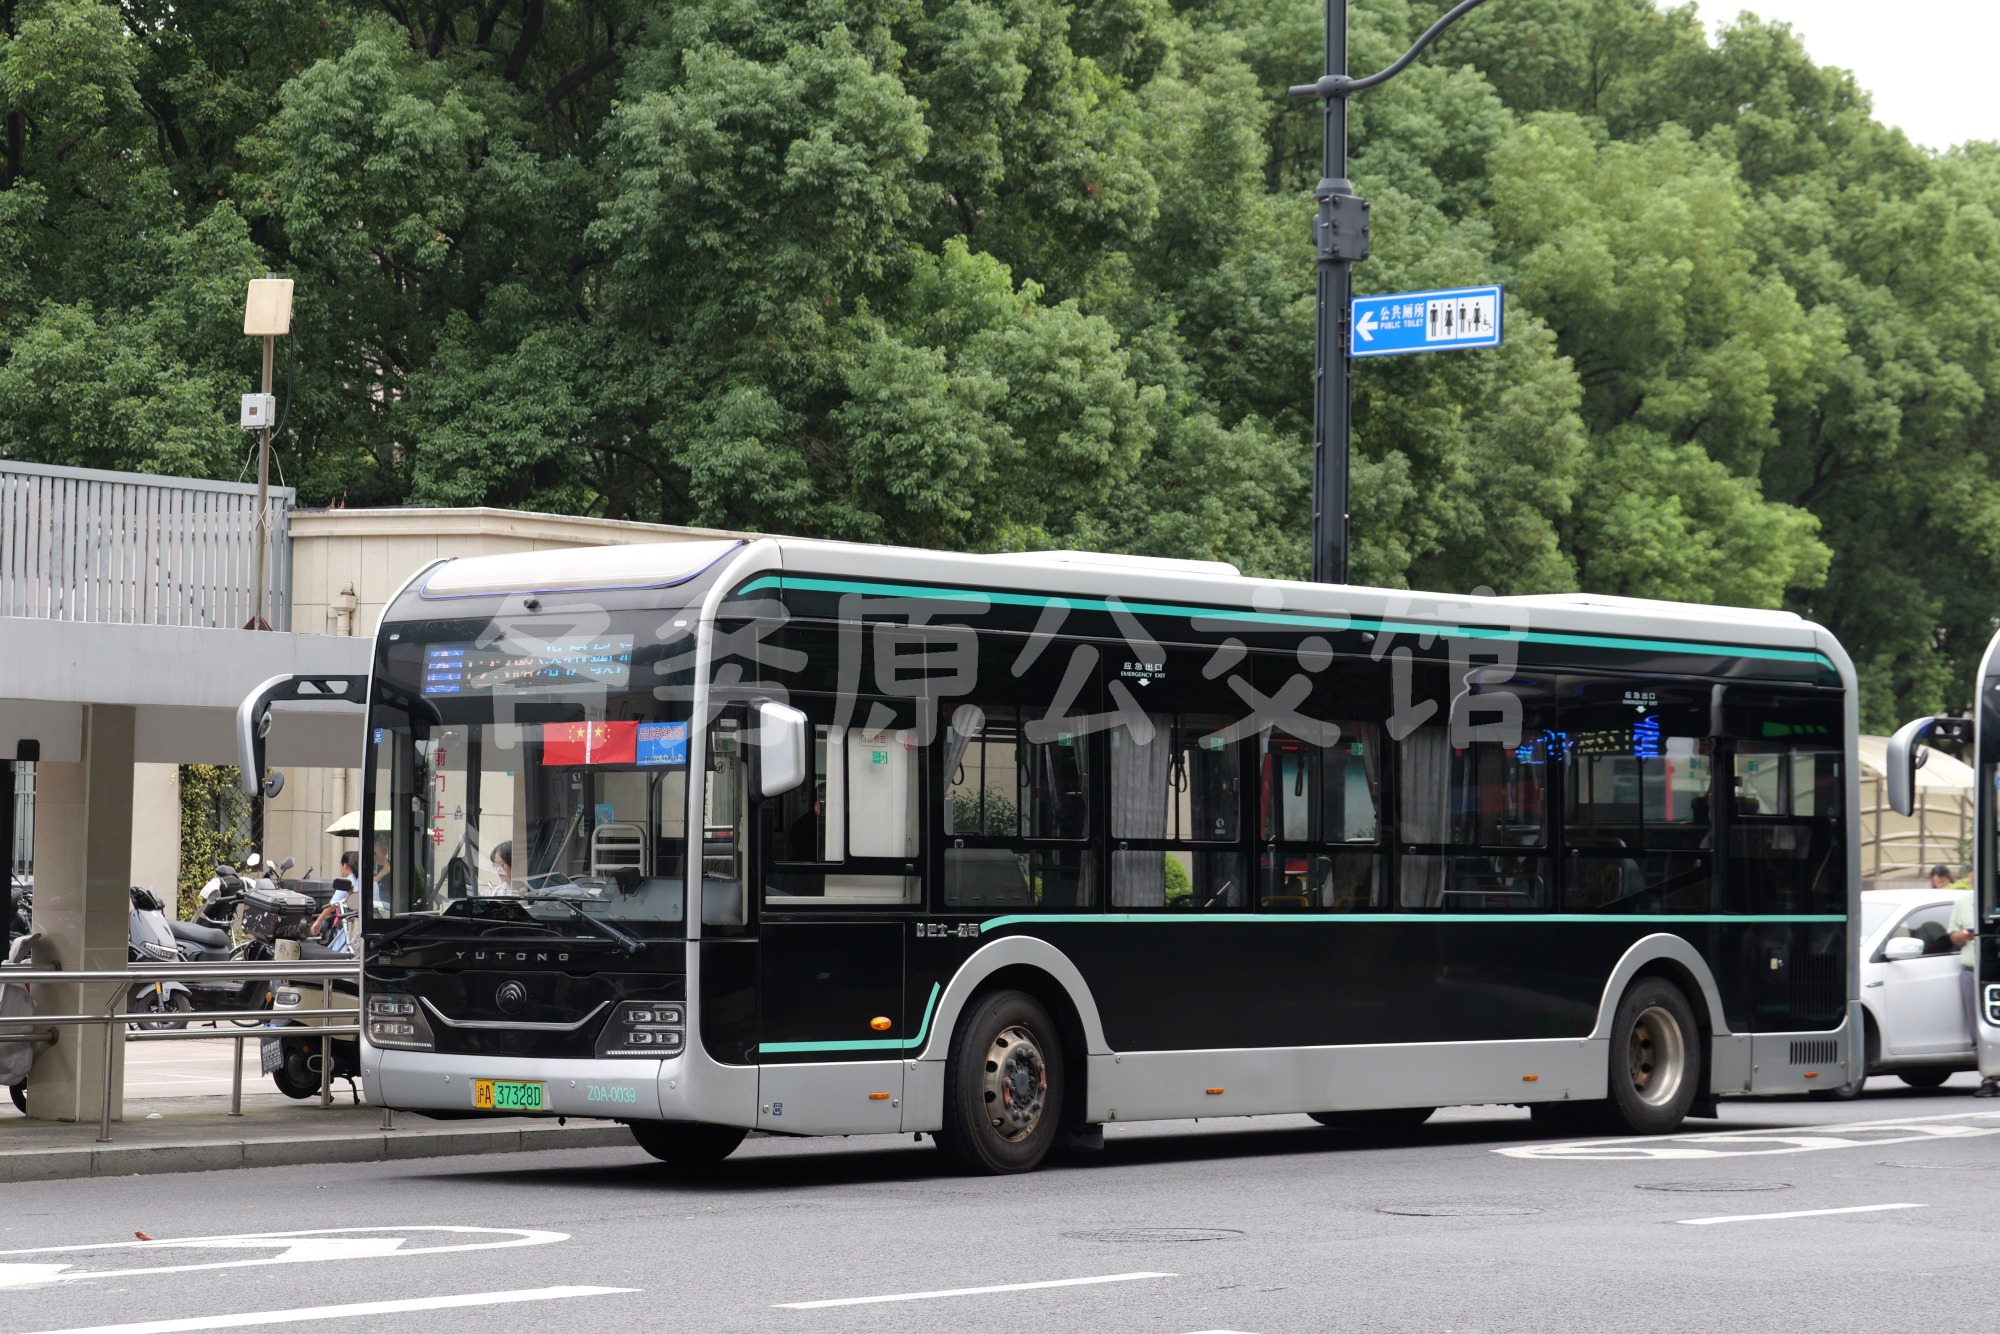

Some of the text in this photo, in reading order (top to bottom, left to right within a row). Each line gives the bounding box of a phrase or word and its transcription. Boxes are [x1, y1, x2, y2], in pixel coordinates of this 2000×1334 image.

[1380, 319, 1424, 330] PUBLIC TOILET
[1123, 661, 1163, 671] 应急出口
[432, 747, 447, 846] 前门上车
[456, 951, 569, 962] YUTONG
